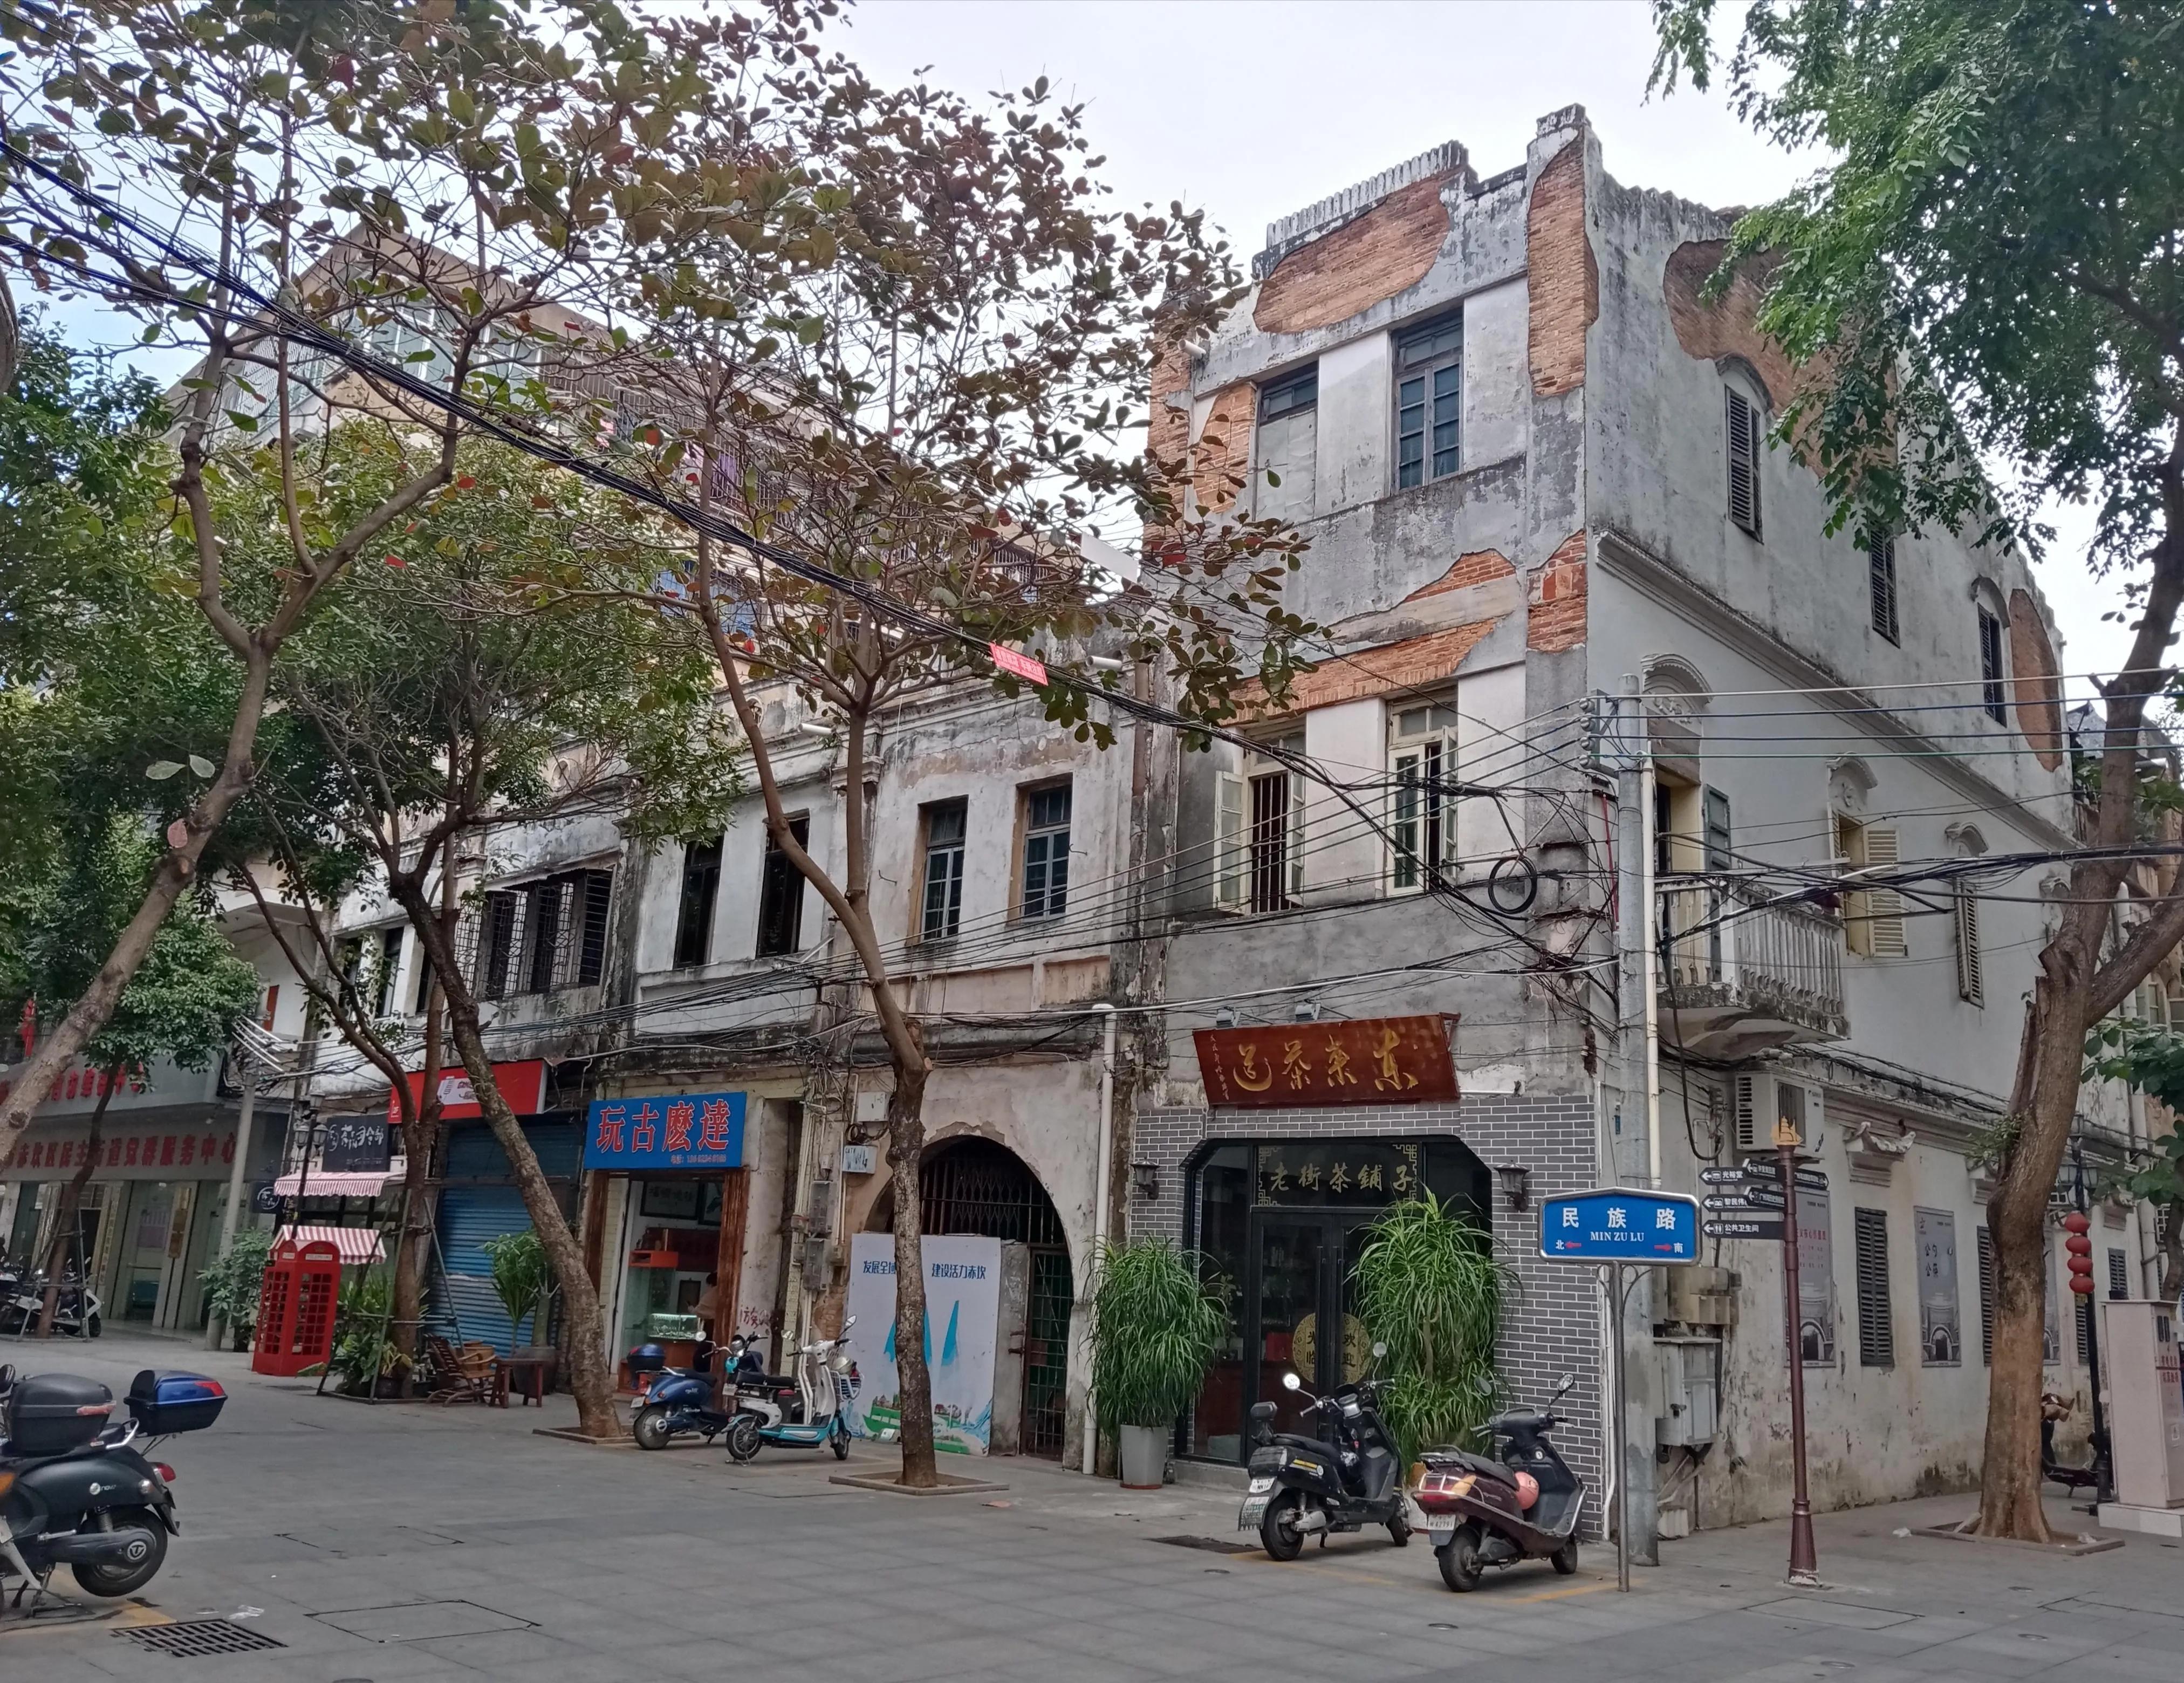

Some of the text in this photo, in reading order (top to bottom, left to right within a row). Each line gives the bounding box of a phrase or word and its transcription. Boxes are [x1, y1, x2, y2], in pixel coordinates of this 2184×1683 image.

[1722, 1171, 1743, 1179] 光裕堂
[1562, 1207, 1676, 1230] 民族路
[1724, 1224, 1759, 1233] 公共卫生间
[1590, 1232, 1644, 1242] MIN ZU LU
[1556, 1240, 1565, 1250] 北
[1673, 1242, 1683, 1254] 南
[932, 1263, 986, 1279] 建设活力赤坎
